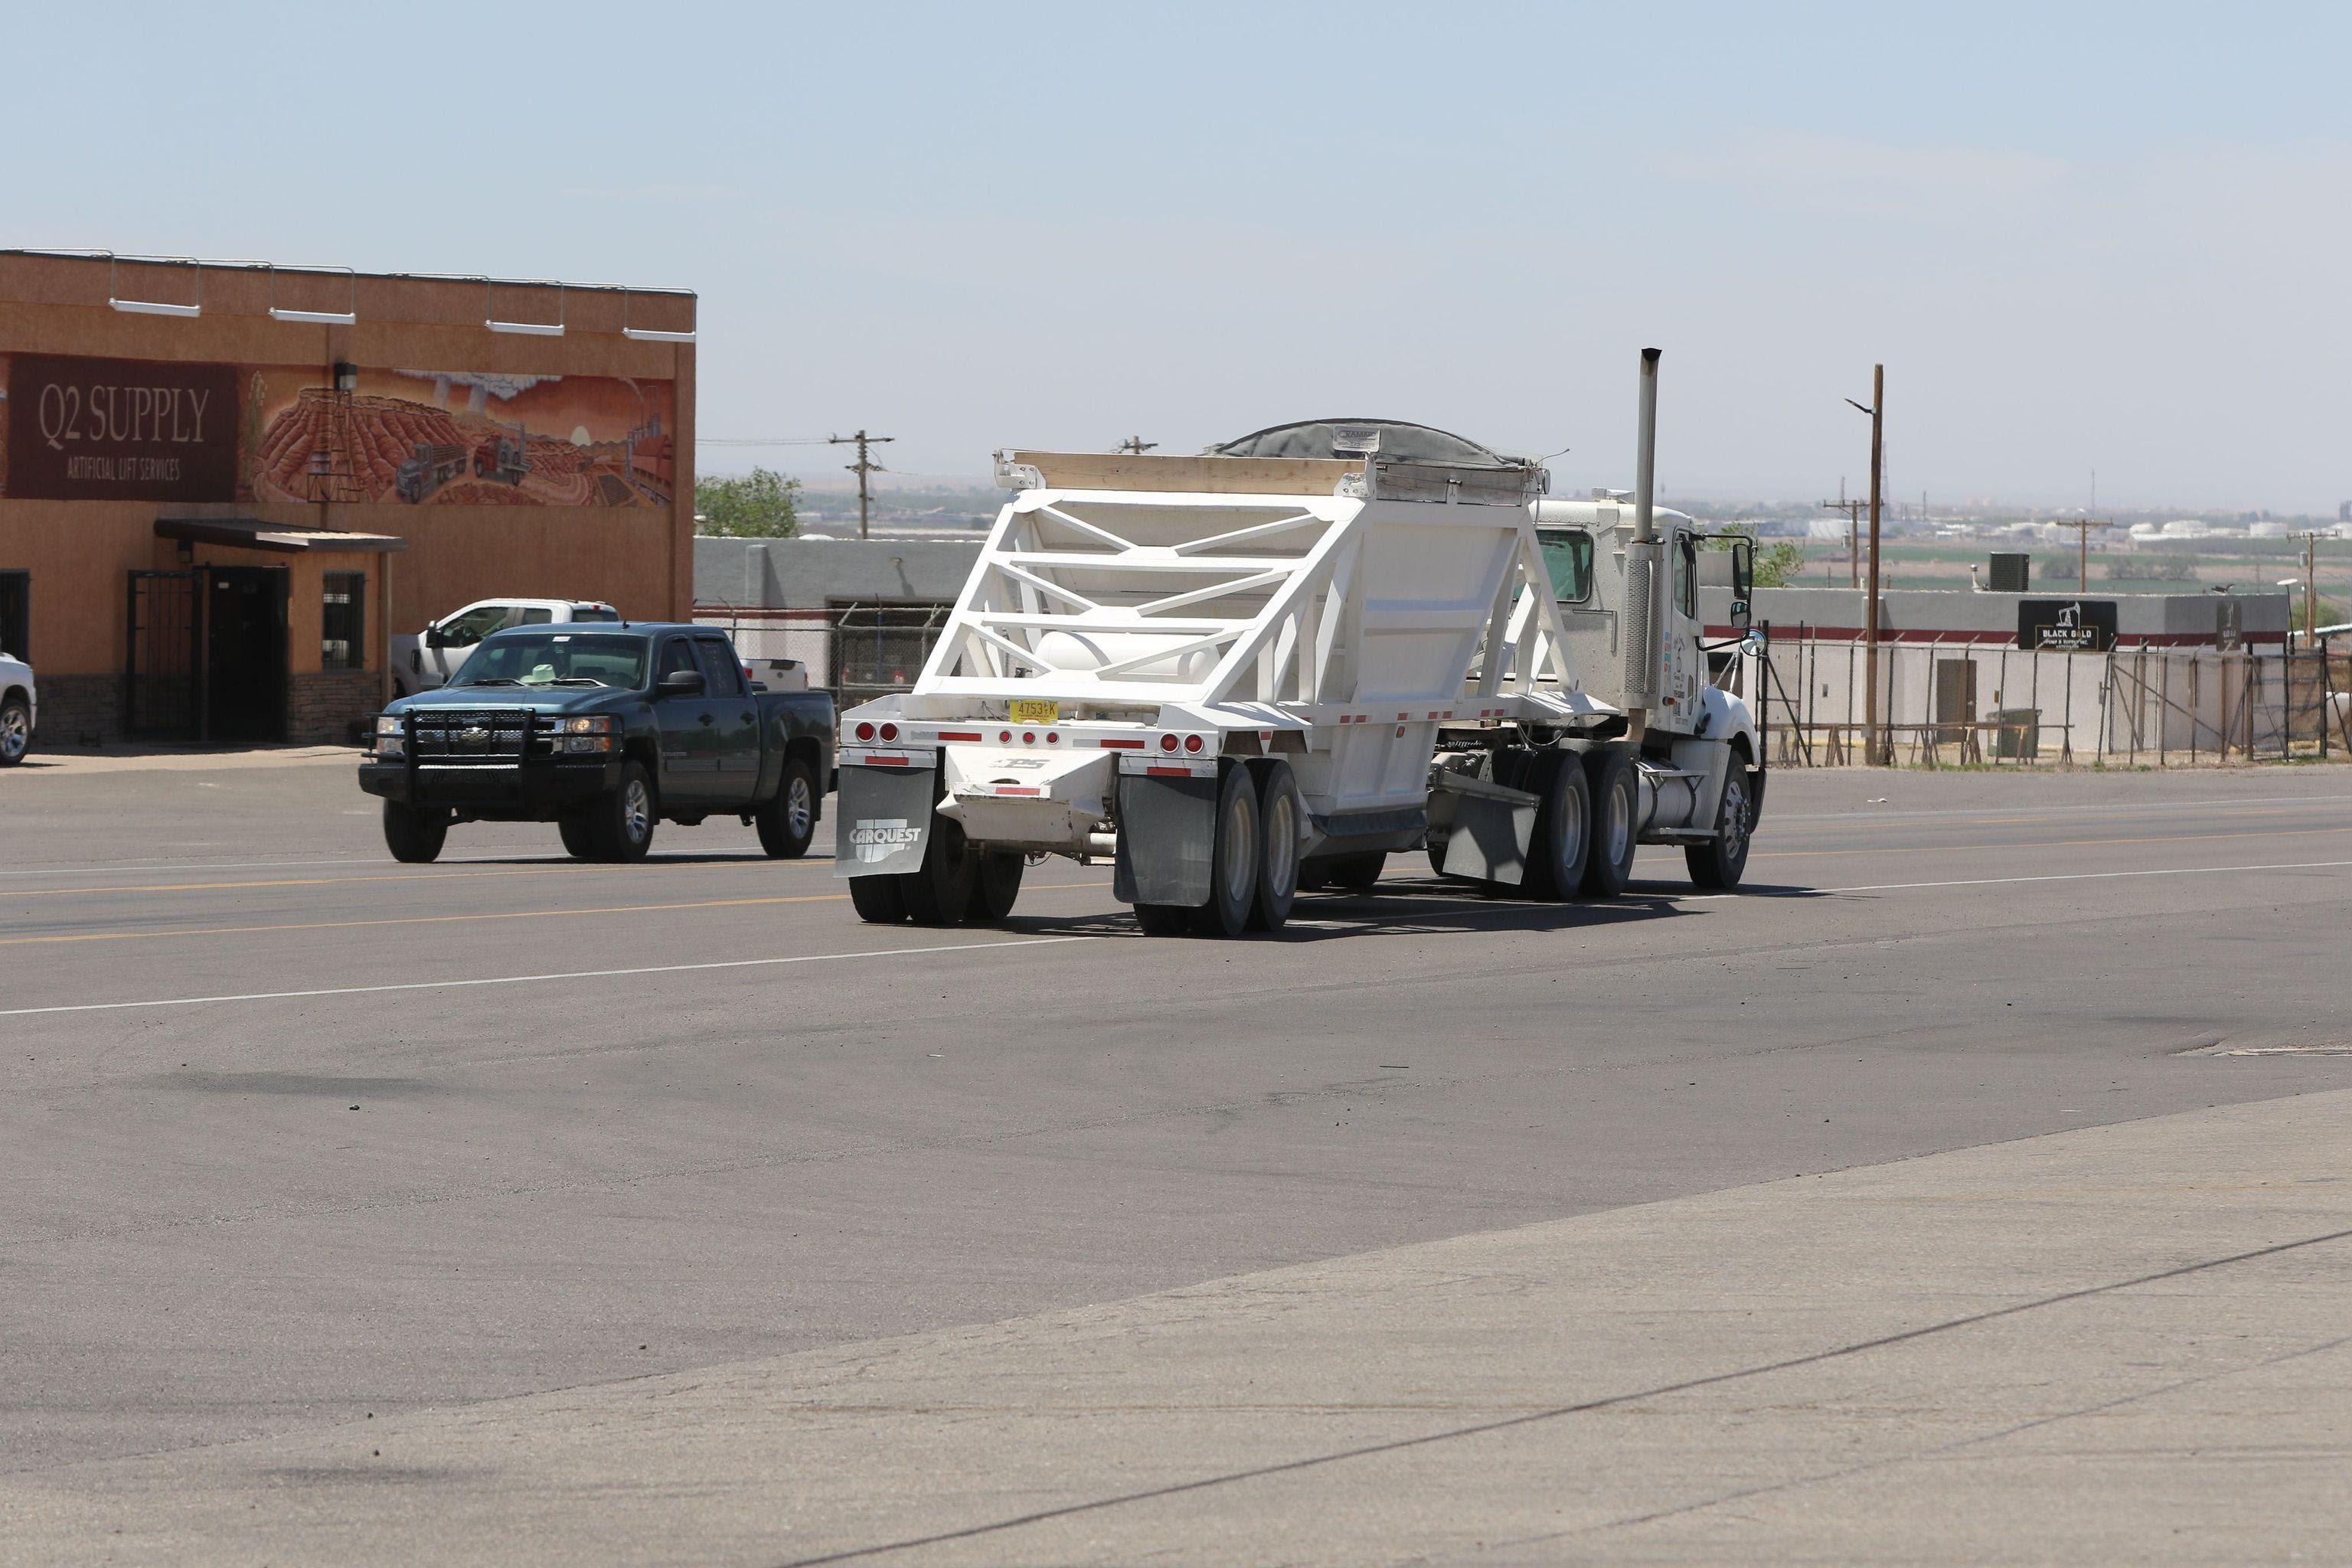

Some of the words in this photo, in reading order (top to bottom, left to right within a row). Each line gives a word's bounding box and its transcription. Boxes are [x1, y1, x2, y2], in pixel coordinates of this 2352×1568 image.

[39, 383, 81, 450] Q2
[90, 384, 210, 443] SUPPLY
[67, 456, 116, 480] ARTIFICIAL
[119, 457, 137, 481] LIFT
[140, 458, 180, 481] SERVICES
[2043, 629, 2068, 638] BLACK
[848, 828, 922, 844] CARQUEST
